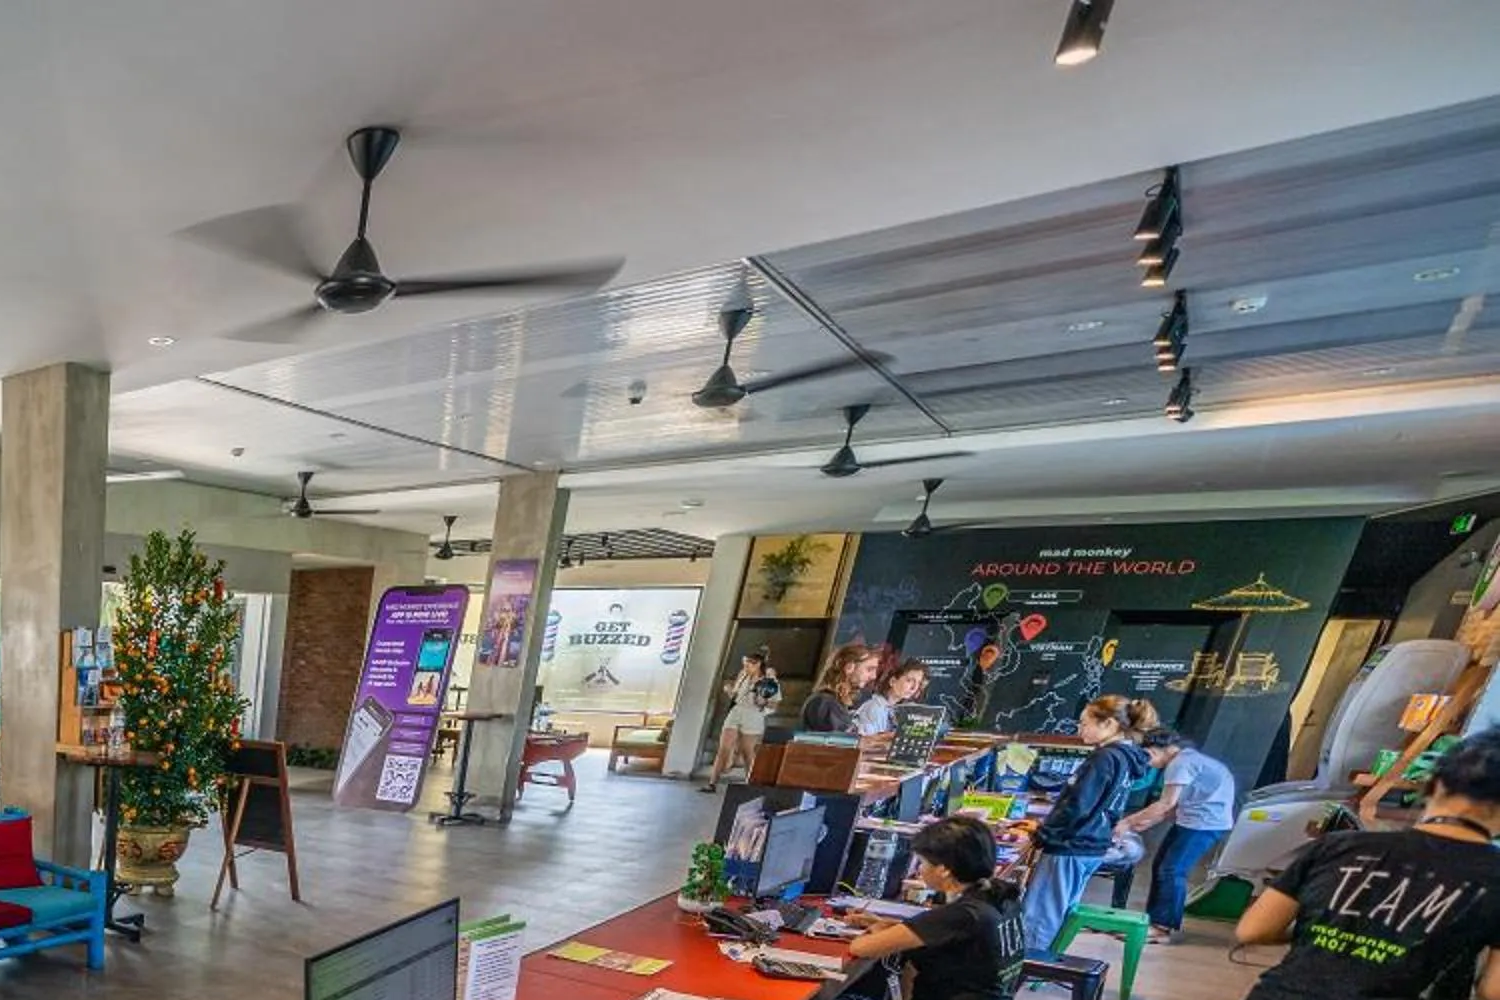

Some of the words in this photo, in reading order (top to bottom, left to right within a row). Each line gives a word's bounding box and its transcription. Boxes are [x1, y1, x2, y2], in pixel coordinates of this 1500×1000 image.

[1039, 547, 1071, 558] mad
[1073, 546, 1132, 559] monkey
[971, 562, 1061, 577] AROUND
[1065, 561, 1106, 576] THE
[1112, 560, 1196, 575] WORLD
[595, 621, 631, 633] GET
[569, 633, 651, 647] BUZZED
[1328, 866, 1462, 933] TEAM
[1339, 931, 1407, 957] monkey
[1350, 945, 1388, 963] AN
